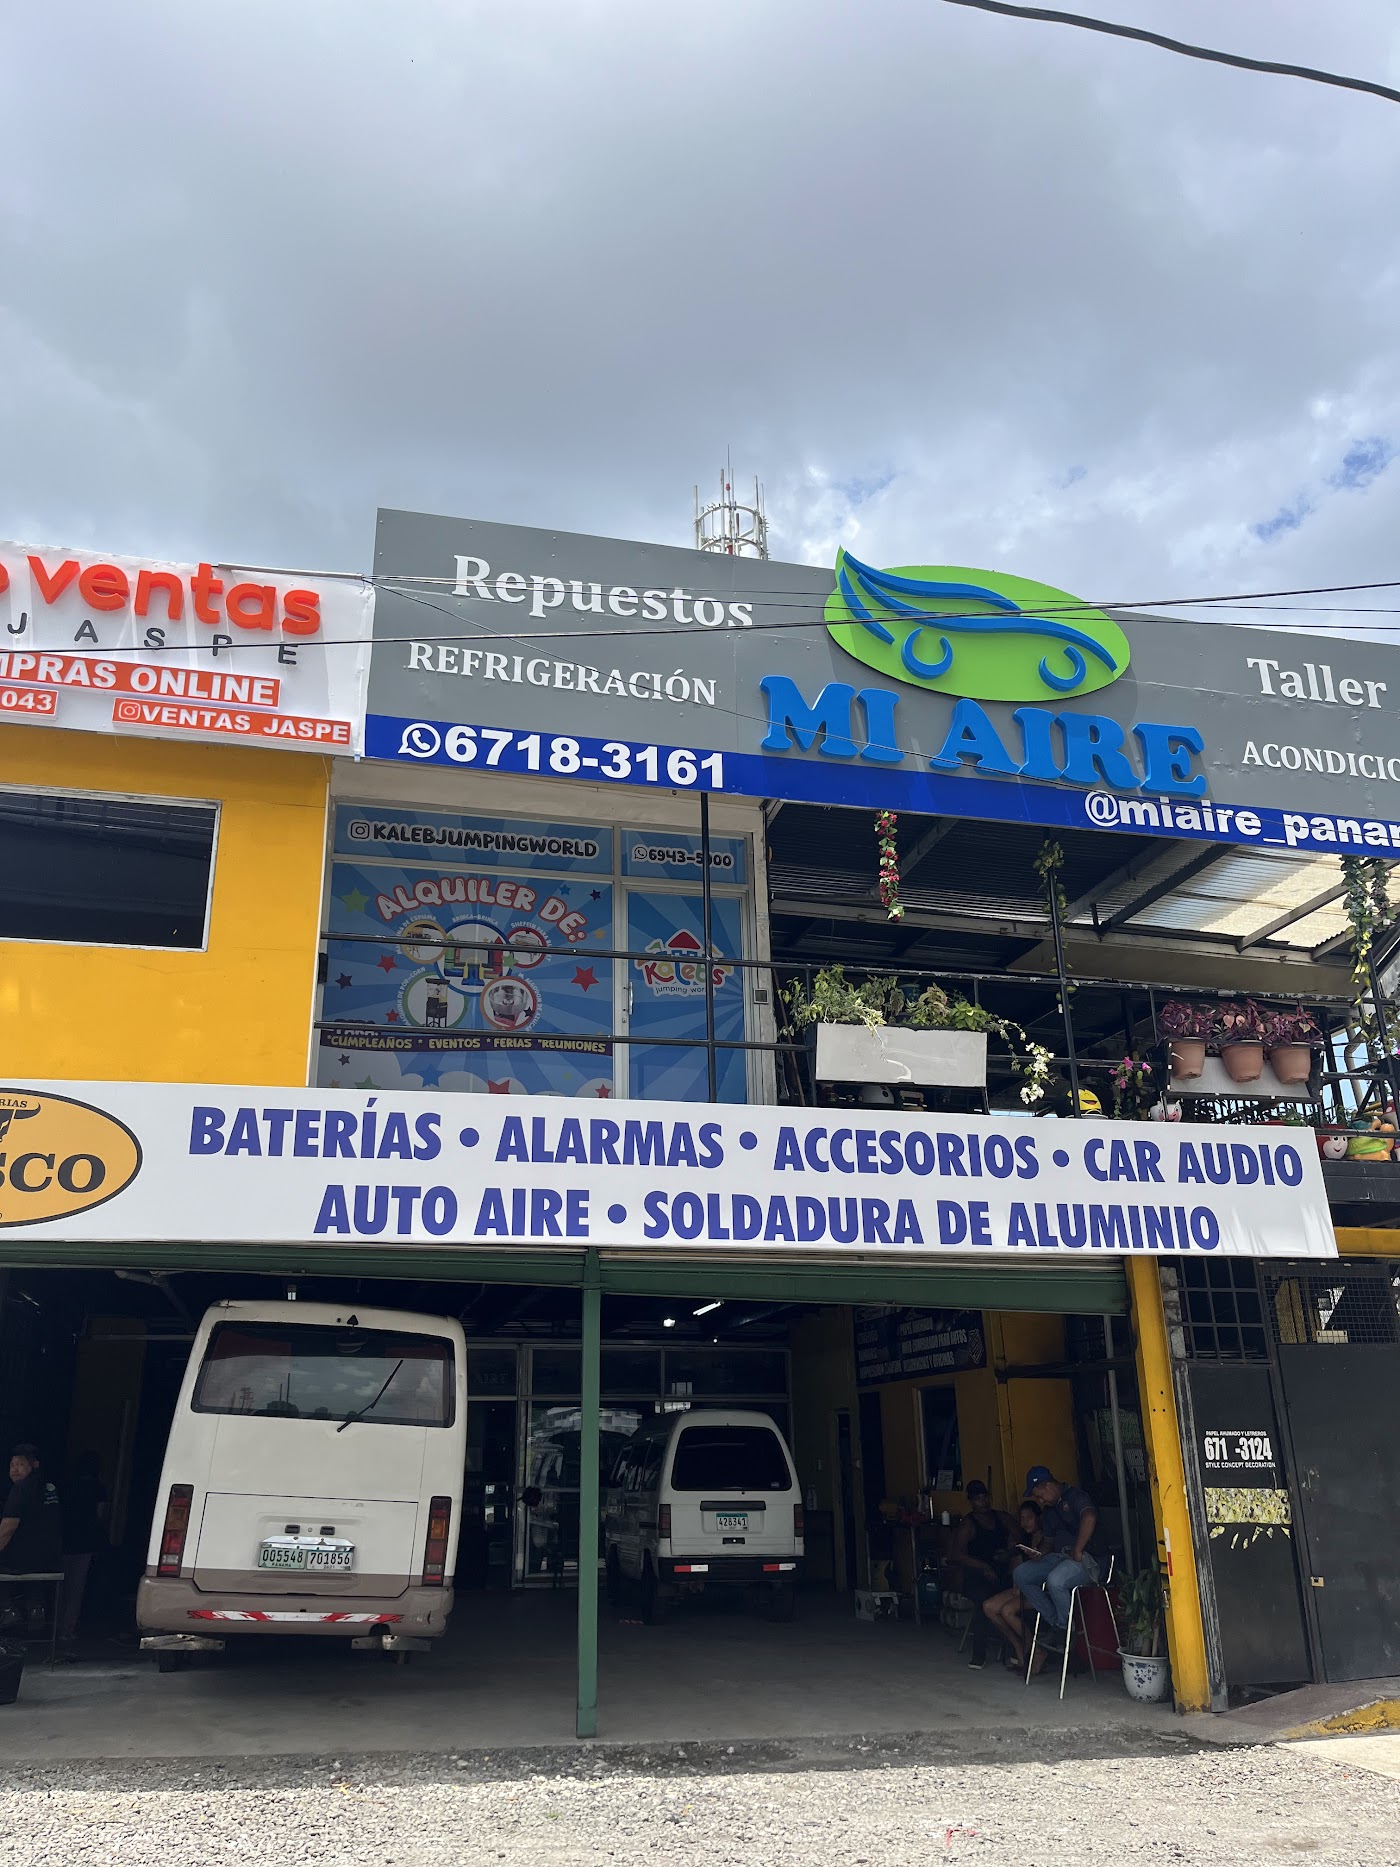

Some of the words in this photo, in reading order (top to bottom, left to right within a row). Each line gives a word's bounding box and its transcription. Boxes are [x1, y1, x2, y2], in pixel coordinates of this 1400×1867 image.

[27, 556, 321, 635] ventas
[452, 554, 753, 627] Repuestos
[130, 666, 276, 705] ONLINE
[407, 641, 717, 705] REFRIGERACIÓN
[1246, 657, 1387, 708] Taller
[140, 704, 251, 732] VENTAS
[263, 717, 348, 742] JASPE
[760, 675, 904, 762] MI
[929, 698, 1207, 796] AIRE
[445, 725, 724, 789] 6718-3161
[373, 823, 597, 857] KALEBJUMPINGWORLD
[649, 848, 732, 867] 6943-500
[378, 877, 536, 920] ALQUILER
[540, 897, 586, 941] DE:
[451, 914, 498, 926] BRINCA-BRINCA
[655, 986, 688, 994] jumping
[429, 1038, 480, 1049] EVENTOS
[493, 1038, 532, 1048] FERIAS
[188, 1097, 442, 1161] BATERÍAS
[495, 1115, 724, 1169] ALARMAS
[773, 1126, 1039, 1180] ACCESORIOS
[1083, 1138, 1166, 1183] CAR
[1177, 1142, 1303, 1187] AUDIO
[314, 1184, 458, 1235] AUTO
[473, 1187, 589, 1237] AIRE
[643, 1190, 924, 1245] SOLDADURA
[937, 1199, 992, 1246] DE
[1007, 1202, 1220, 1250] ALUMINIO
[719, 1517, 746, 1527] 428341
[262, 1549, 304, 1563] 005548
[310, 1552, 350, 1565] 701856
